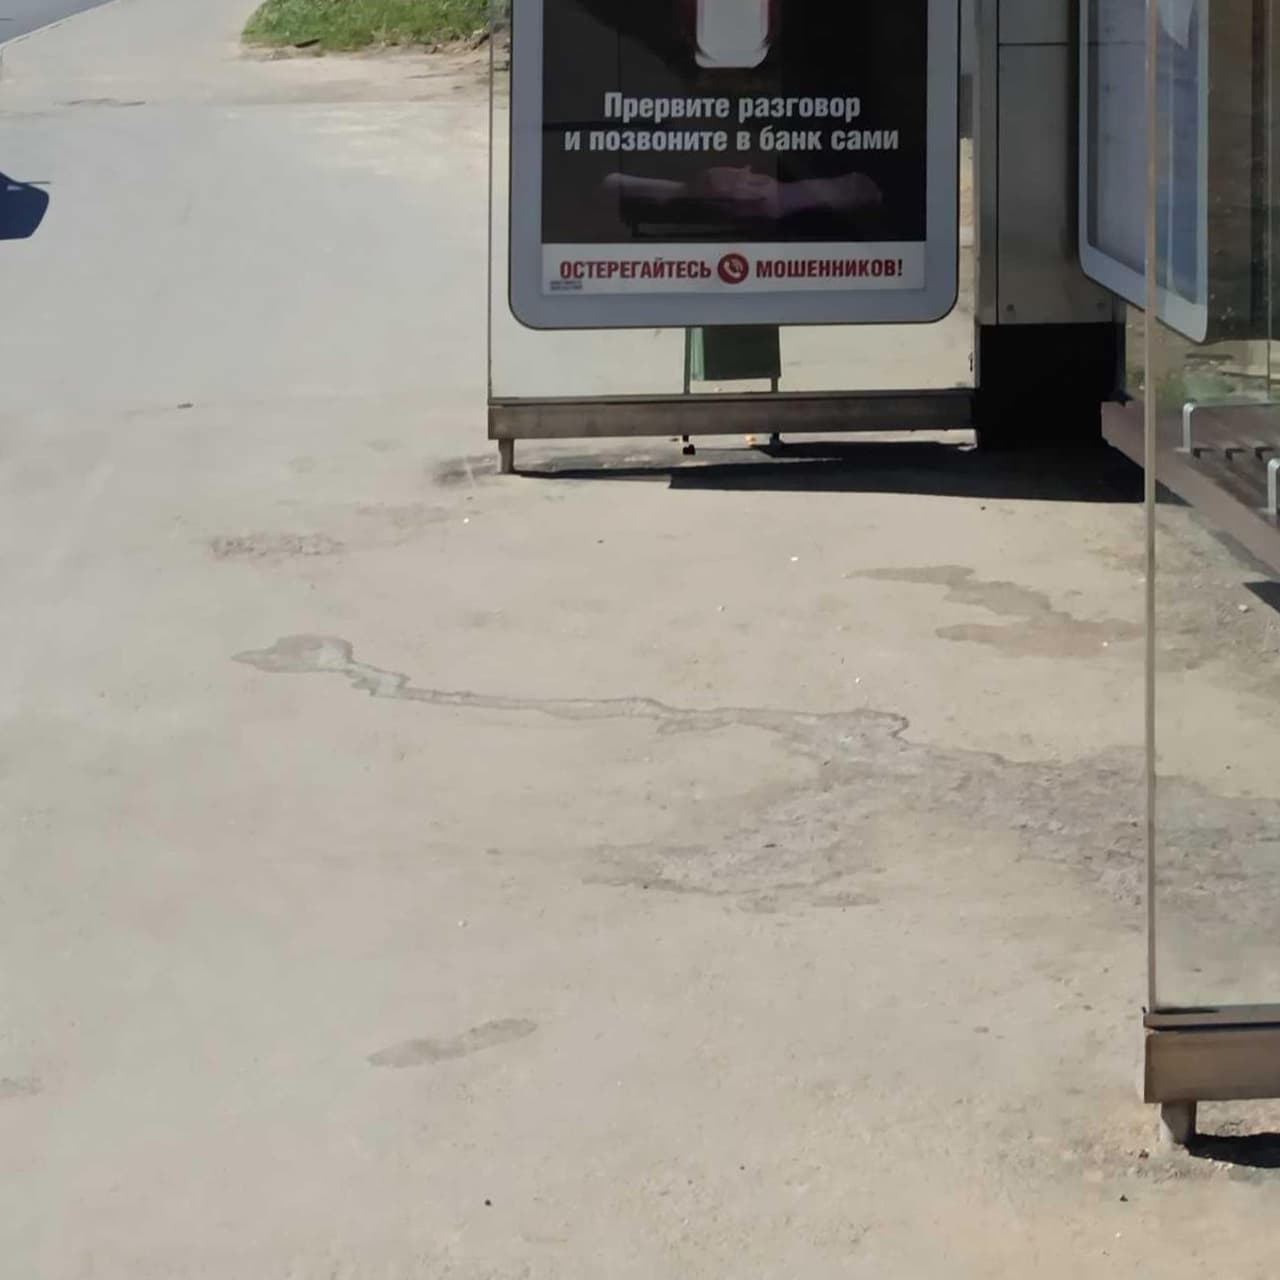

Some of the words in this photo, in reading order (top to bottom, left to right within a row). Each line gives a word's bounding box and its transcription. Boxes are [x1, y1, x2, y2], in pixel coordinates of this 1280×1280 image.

[603, 91, 730, 123] Прервите
[738, 95, 861, 123] разговор
[564, 130, 581, 151] и
[589, 129, 728, 151] позвоните
[736, 130, 751, 151] в
[759, 124, 823, 151] банк
[830, 128, 899, 151] сами
[559, 256, 712, 280] ОСТЕРЕГАЙТЕСЬ
[755, 258, 904, 279] МОШЕННИКОВ!
